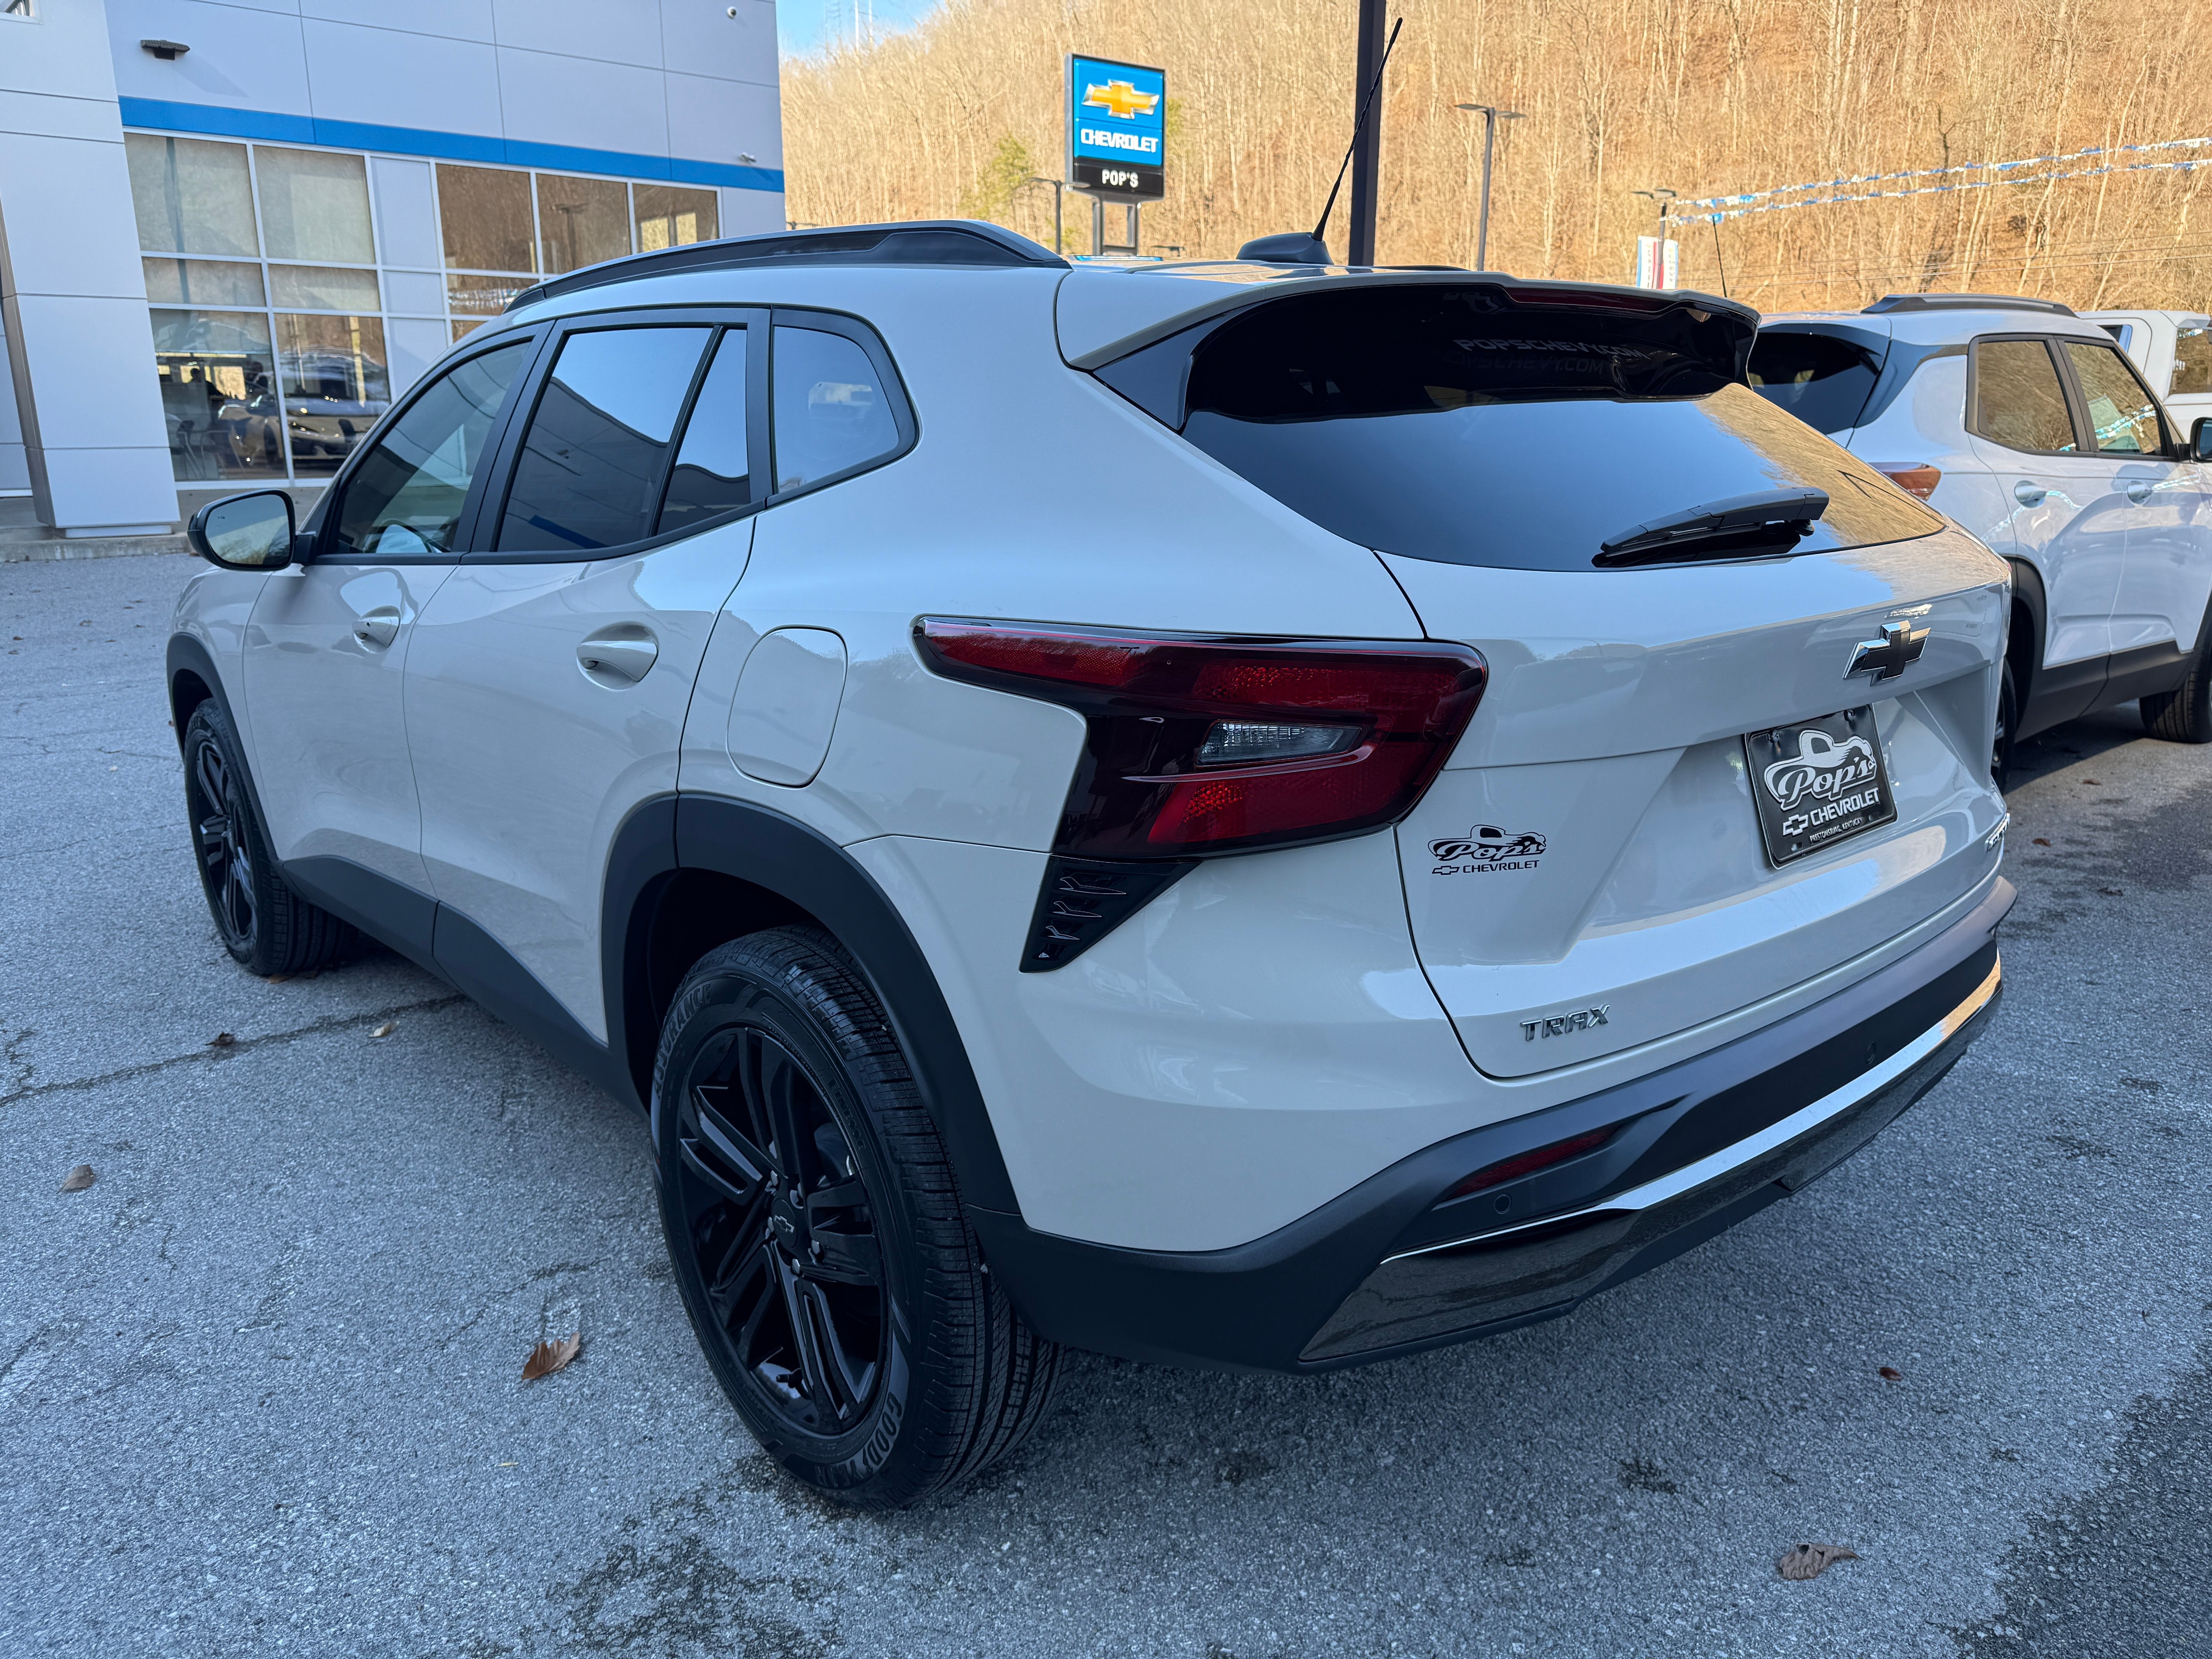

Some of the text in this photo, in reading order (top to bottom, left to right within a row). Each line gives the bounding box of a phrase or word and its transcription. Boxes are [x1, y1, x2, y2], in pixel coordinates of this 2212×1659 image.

[1080, 128, 1158, 153] CHEVROLET
[1102, 168, 1139, 188] POP'S
[1453, 339, 1651, 360] POPSCHEVY.COM
[1778, 756, 1873, 803] Pop's
[1810, 787, 1879, 826] CHEVROLET
[1810, 817, 1863, 842] PRESTONSBURG, KENTUCKY
[1436, 841, 1539, 862] Pop's
[1463, 860, 1540, 873] CHEVROLET
[1520, 1004, 1610, 1041] TRAX
[654, 983, 712, 1099] ASSURANCE
